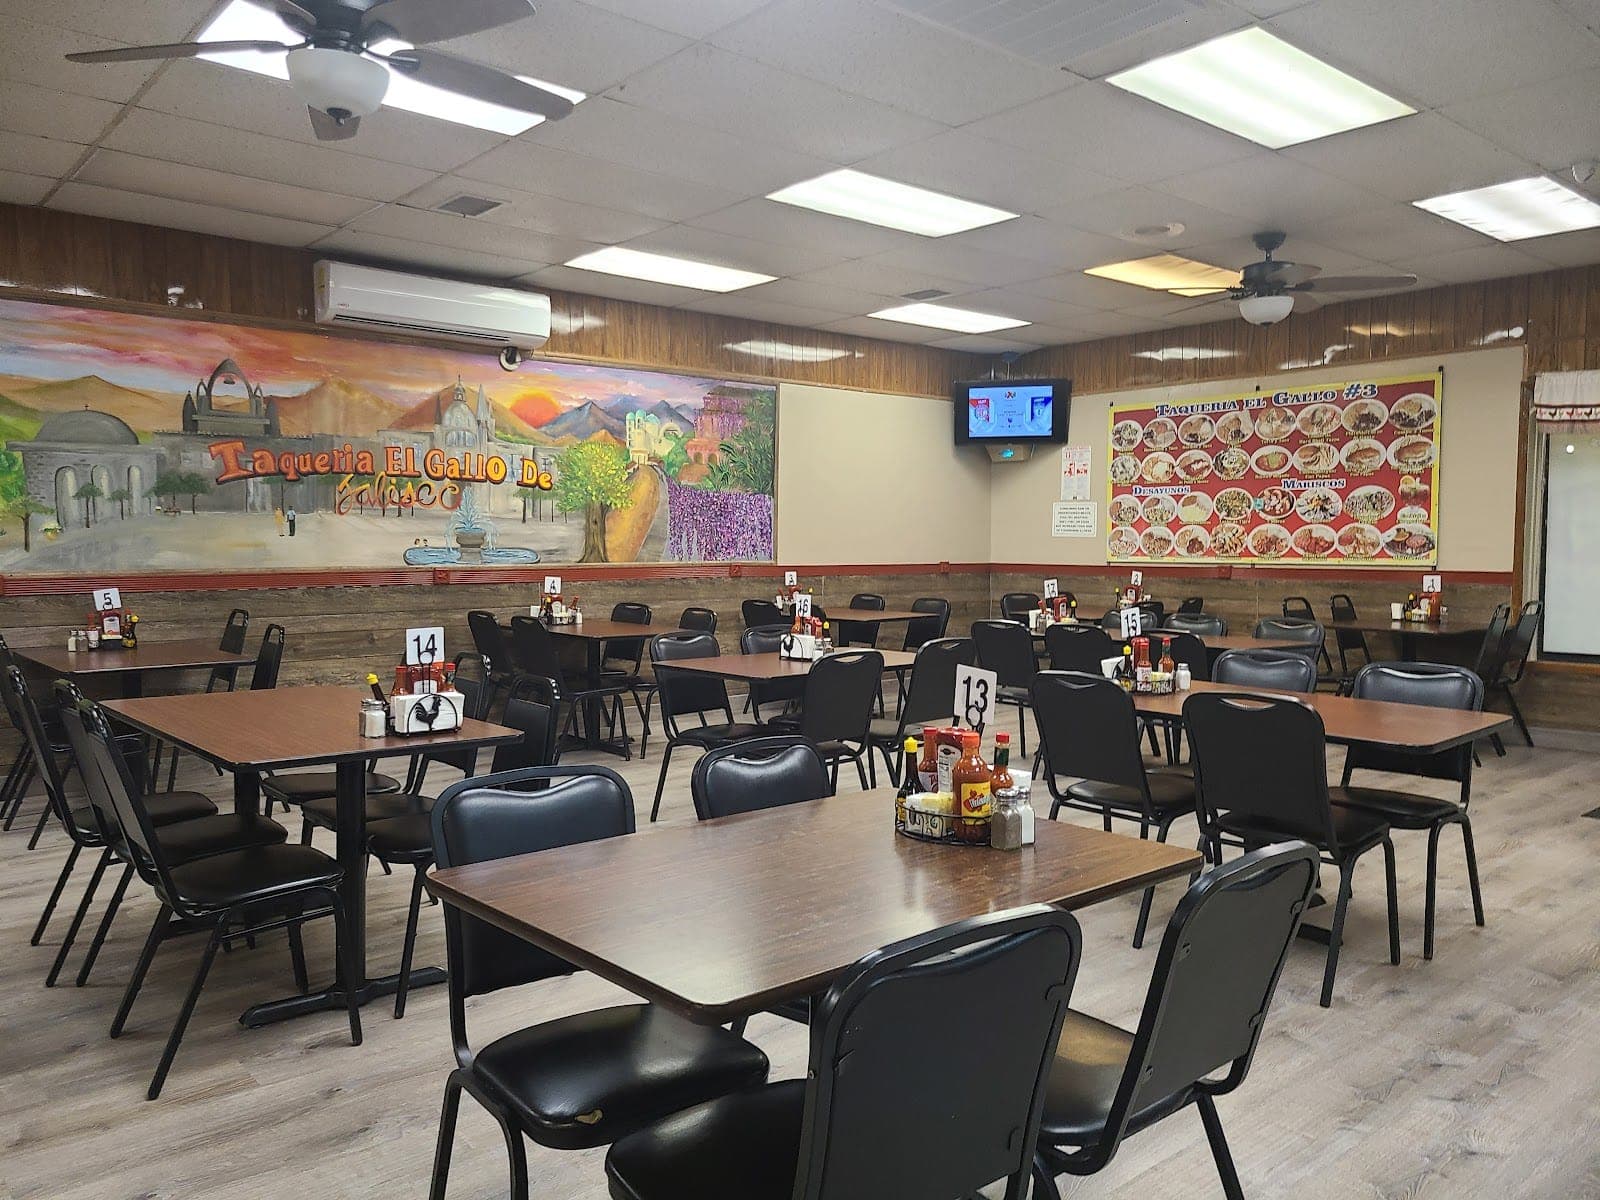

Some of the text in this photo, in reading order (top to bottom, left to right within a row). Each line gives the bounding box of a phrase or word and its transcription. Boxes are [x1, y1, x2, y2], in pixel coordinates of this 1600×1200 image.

[1243, 398, 1266, 410] EL
[1272, 389, 1336, 406] GALLO
[1343, 383, 1378, 399] #3
[208, 440, 553, 491] Taqueria El Gallo De
[336, 471, 462, 515] Jalisco
[1133, 486, 1190, 496] DESAYUNOS
[1282, 479, 1345, 488] MARISCOS
[103, 592, 112, 606] 5
[798, 598, 808, 614] 16
[1124, 613, 1138, 634] 15
[412, 633, 438, 659] 14
[962, 675, 989, 712] 13
